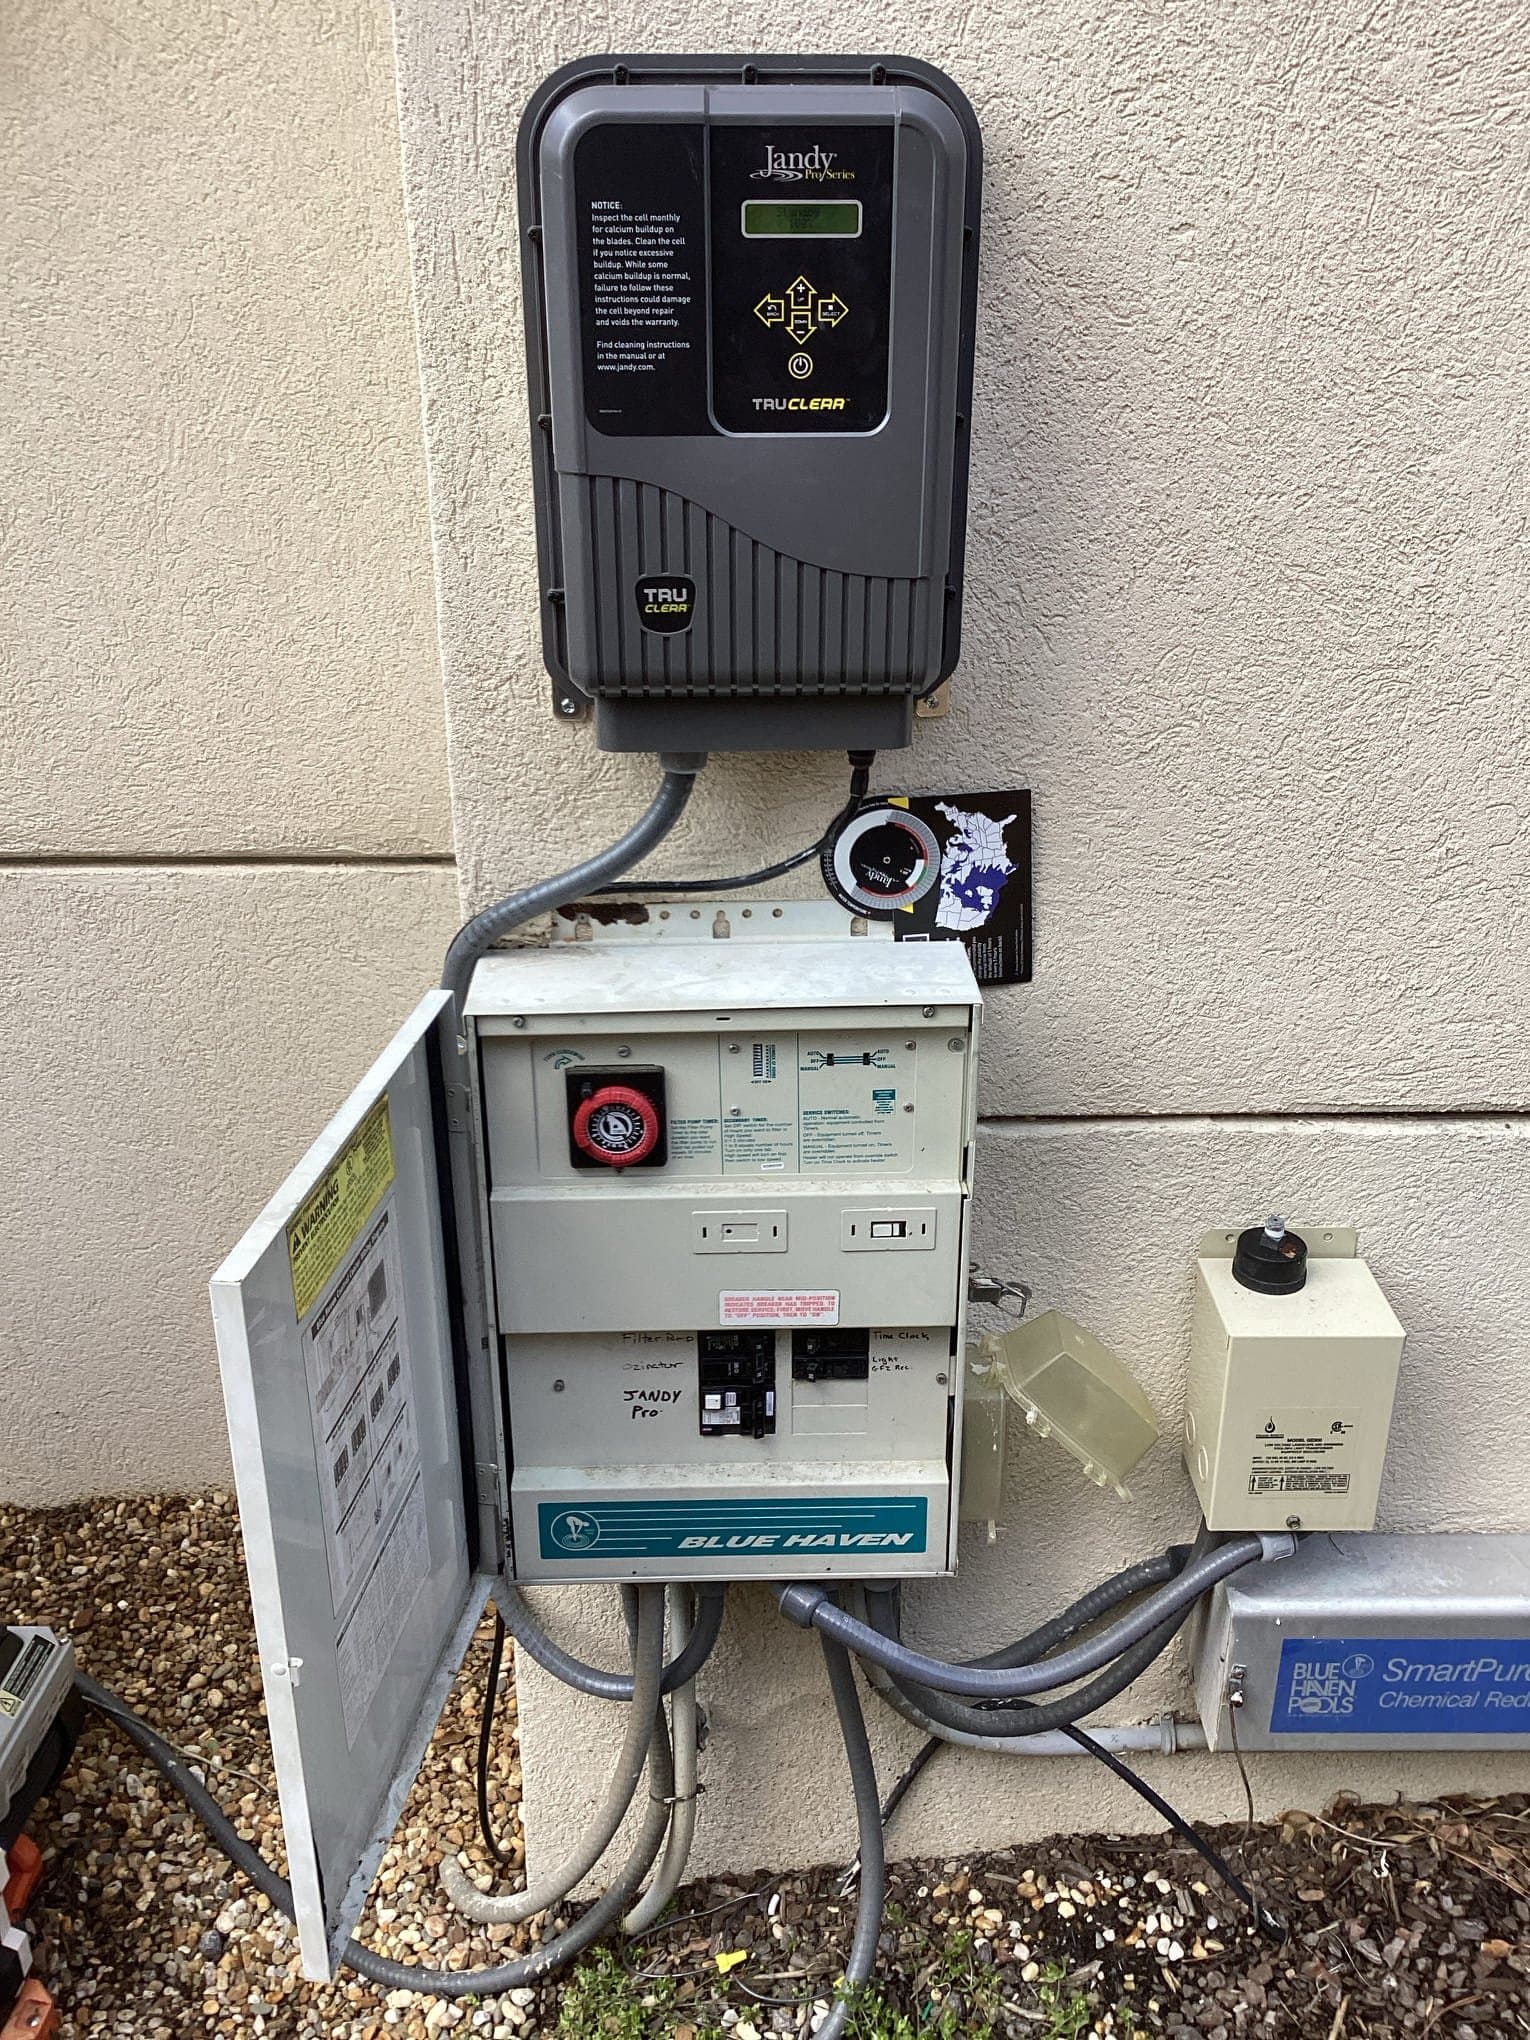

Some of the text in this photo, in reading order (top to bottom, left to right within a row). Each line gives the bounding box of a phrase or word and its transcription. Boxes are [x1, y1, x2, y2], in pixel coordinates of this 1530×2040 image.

[760, 145, 836, 181] Jandy
[826, 168, 855, 180] Series
[592, 214, 619, 222] Inspect
[650, 214, 680, 222] monthly
[636, 225, 663, 234] buildup
[624, 272, 652, 281] buildup
[662, 272, 690, 280] normal,
[662, 296, 691, 304] damage
[624, 307, 650, 316] beyond
[652, 307, 674, 316] repair
[645, 318, 679, 327] warranty.
[614, 341, 645, 350] cleaning
[644, 588, 687, 602] TRU
[644, 604, 688, 613] CLEAR
[302, 1178, 340, 1237] WARNING
[624, 1390, 682, 1403] JANDY
[677, 1533, 914, 1548] BLUE HAVEN
[1294, 1663, 1341, 1680] BLUE
[1291, 1680, 1356, 1696] HAVEN
[1380, 1691, 1530, 1708] Chemical Red
